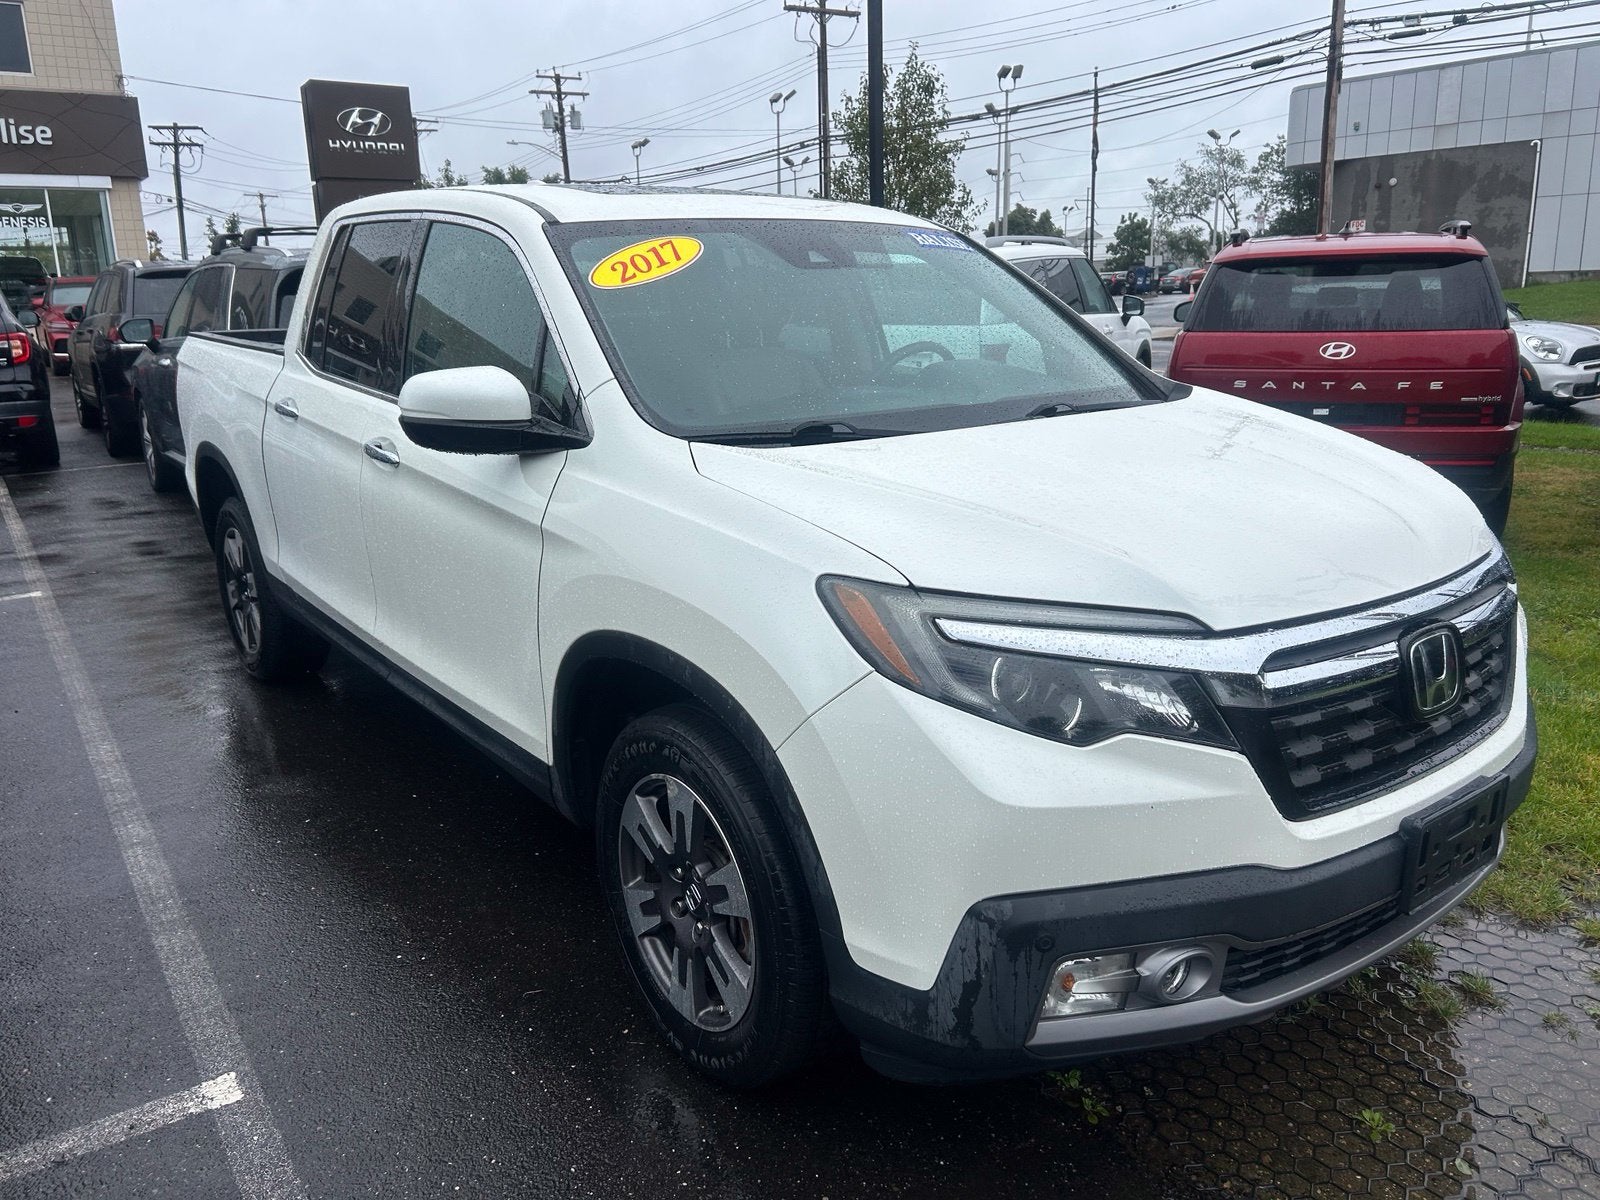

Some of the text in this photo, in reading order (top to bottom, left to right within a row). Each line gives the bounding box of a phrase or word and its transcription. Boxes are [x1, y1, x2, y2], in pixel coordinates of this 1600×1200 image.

[0, 118, 53, 145] lise
[328, 139, 405, 155] HYUNDAI
[610, 240, 682, 283] 2017
[1234, 380, 1444, 390] SANTA FE
